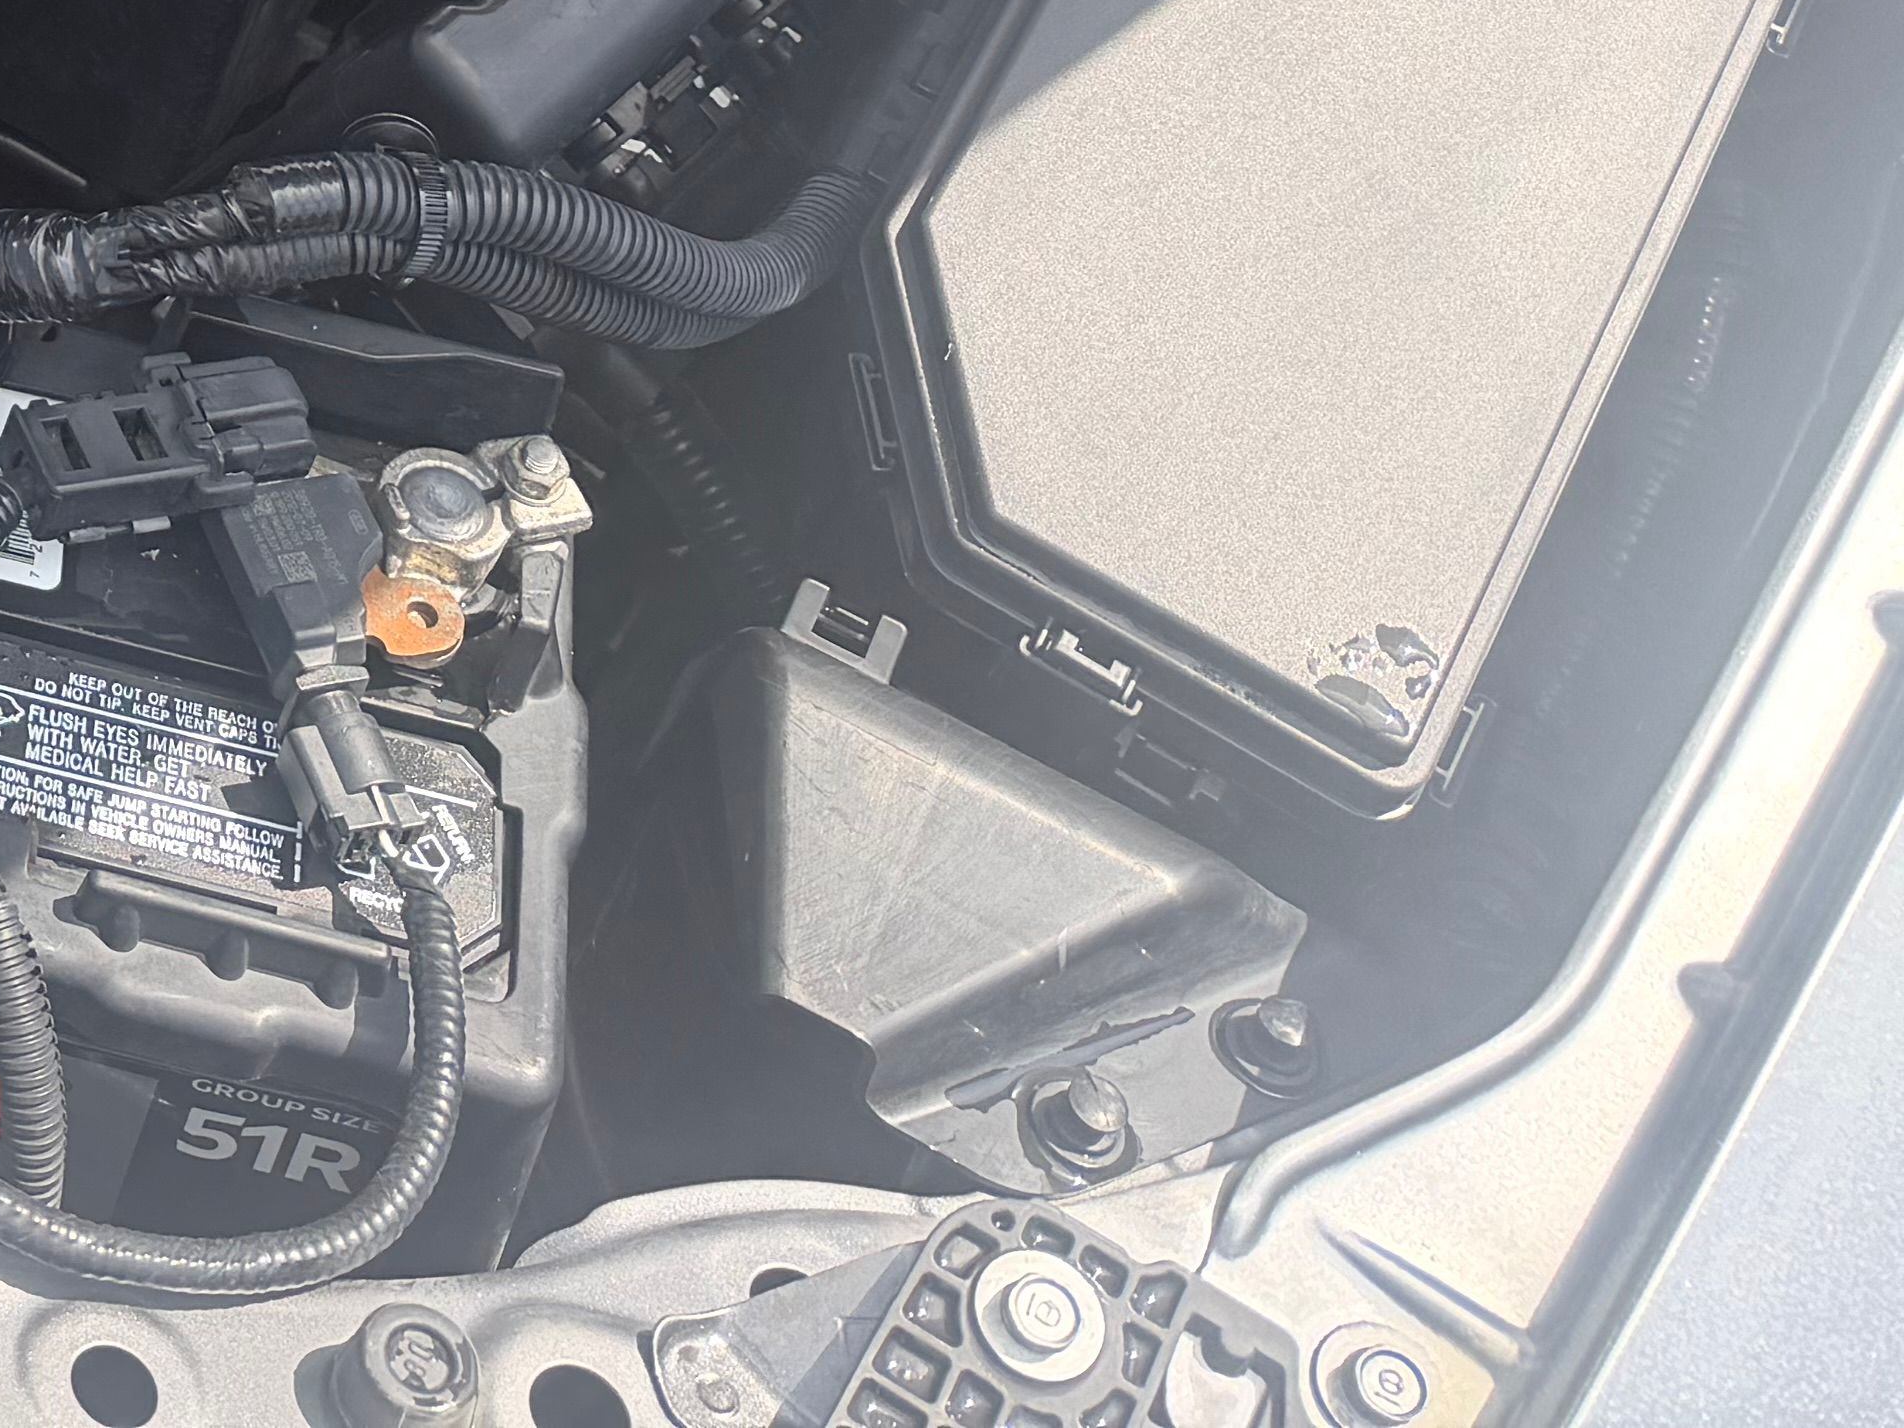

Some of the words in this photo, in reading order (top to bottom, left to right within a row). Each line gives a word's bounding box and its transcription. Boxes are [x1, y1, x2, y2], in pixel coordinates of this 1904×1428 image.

[32, 677, 58, 696] DO
[59, 683, 93, 705] NOT
[97, 693, 127, 713] TIP.
[129, 701, 171, 724] KEEP
[171, 711, 214, 735] VENT
[215, 722, 259, 746] CAPS
[260, 734, 283, 751] TI
[66, 671, 107, 693] KEEP
[109, 681, 143, 702] OUT
[147, 691, 168, 708] OF
[171, 697, 205, 718] THE
[205, 705, 259, 732] REACH
[23, 721, 75, 751] WITH
[151, 753, 191, 779] GET
[26, 702, 90, 735] FLUSH
[91, 718, 142, 747] EYES
[143, 731, 268, 778] IMMEDIATELY
[22, 740, 106, 778] MEDICAL
[108, 762, 161, 791] HELP
[161, 775, 212, 803] FAST
[32, 773, 64, 794] FOR
[65, 781, 105, 804] SAFE
[105, 792, 147, 814] JUMP
[148, 802, 223, 833] STARTING
[222, 821, 286, 850] FOLLOW
[69, 798, 84, 814] IN
[89, 803, 151, 831] VEHICLE
[150, 818, 217, 848] OWNERS
[87, 818, 130, 842] SEEK
[130, 829, 191, 857] SERVICE
[431, 804, 476, 864] RETURN
[348, 886, 406, 914] RECY
[192, 1078, 307, 1113] GROUP
[311, 1106, 382, 1135] SIZE
[176, 1106, 362, 1195] 51R
